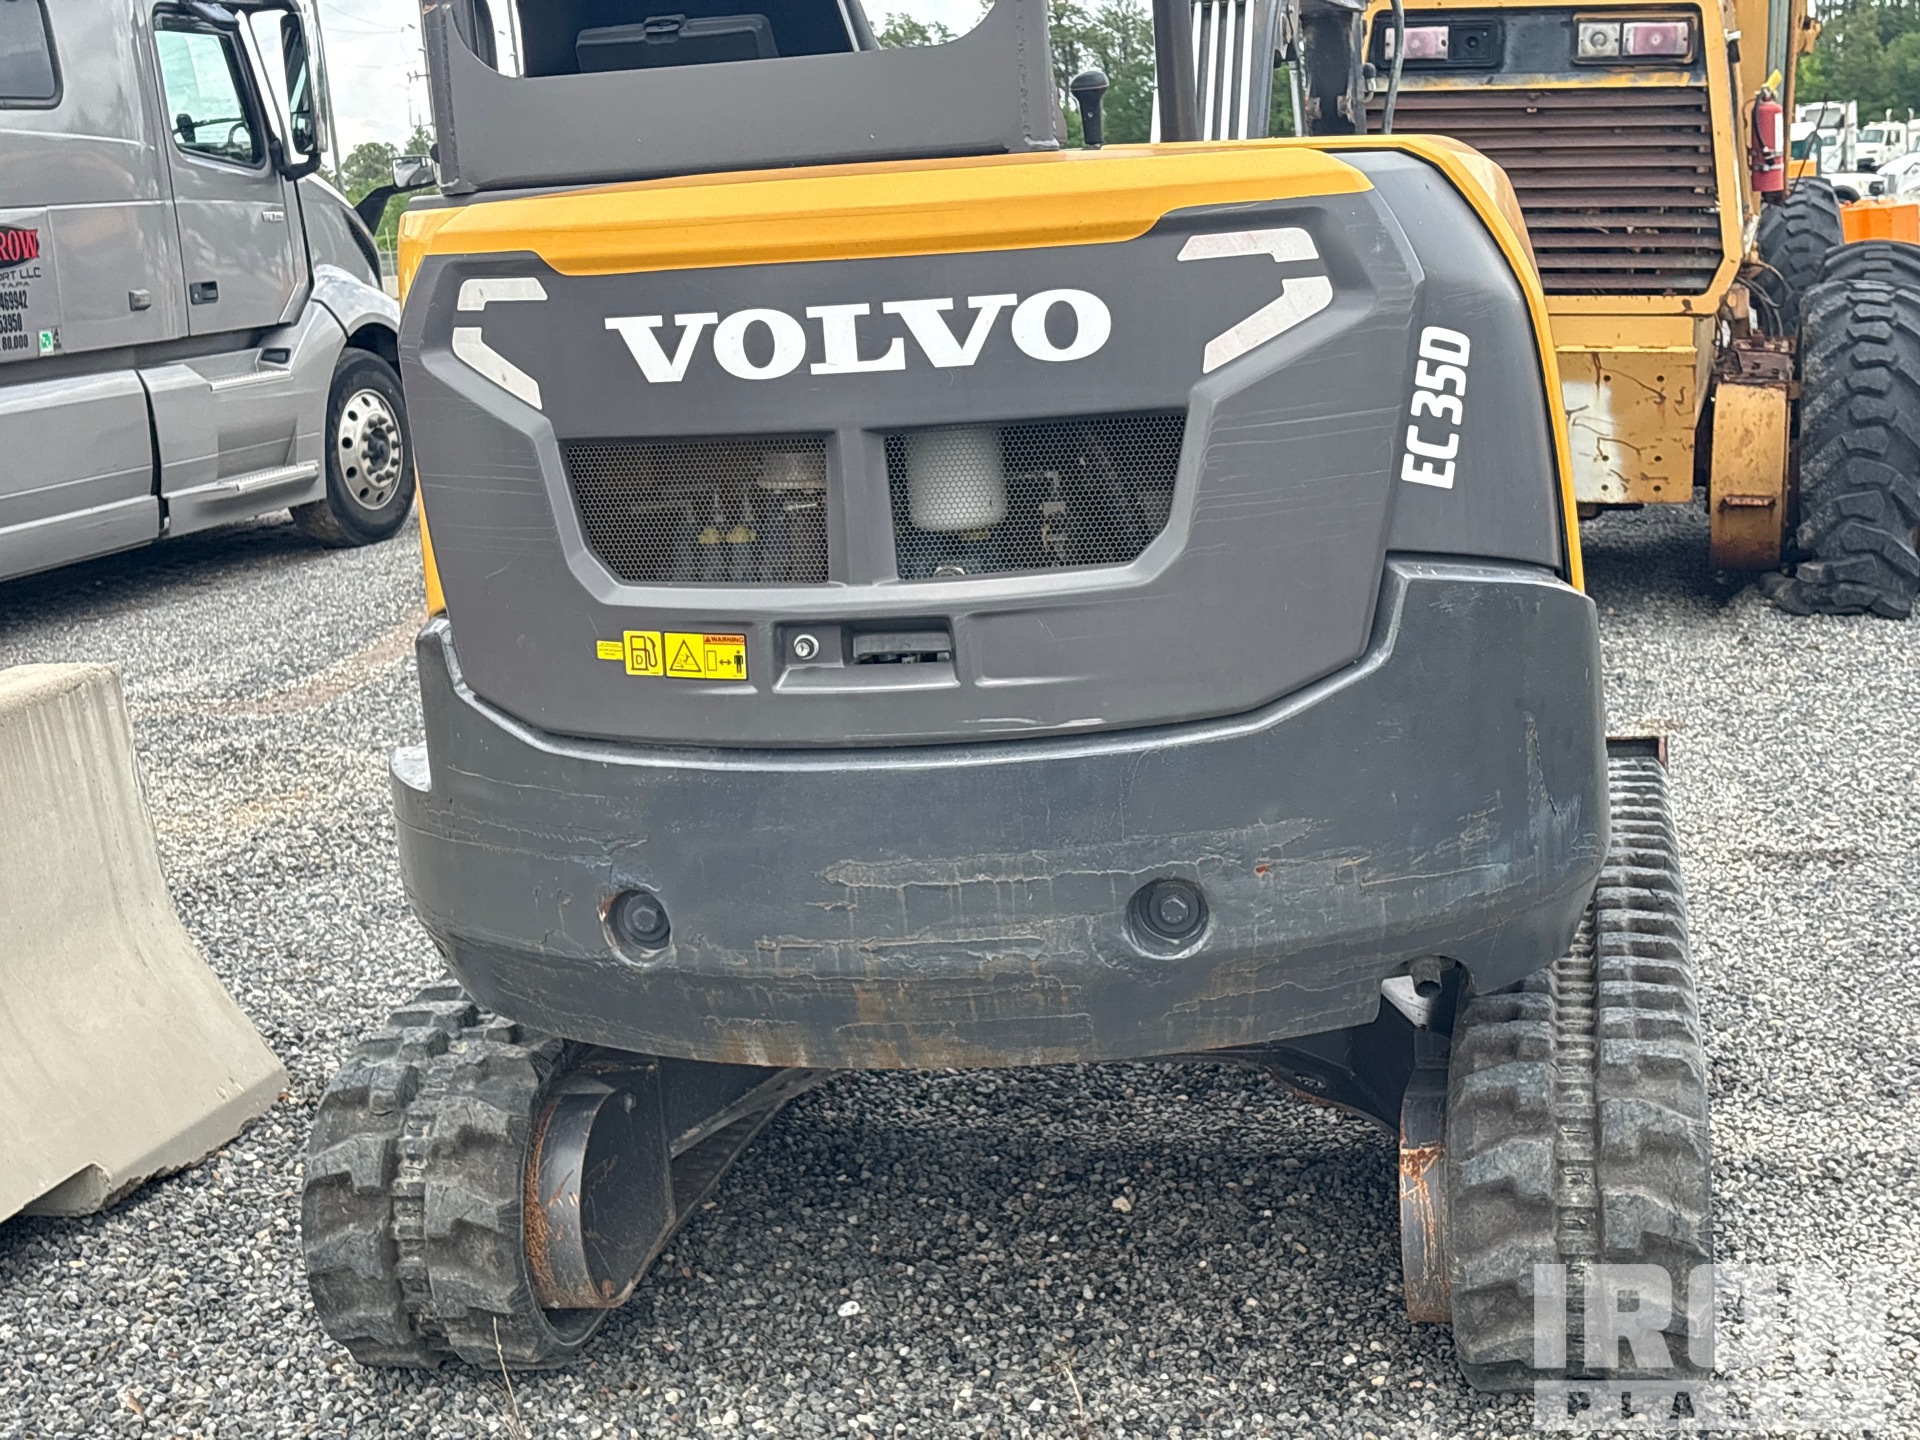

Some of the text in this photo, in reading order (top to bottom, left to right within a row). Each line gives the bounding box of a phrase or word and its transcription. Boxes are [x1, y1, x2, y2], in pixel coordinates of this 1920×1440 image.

[20, 267, 41, 279] LLC
[604, 288, 1112, 383] VOLVO
[635, 654, 643, 665] D
